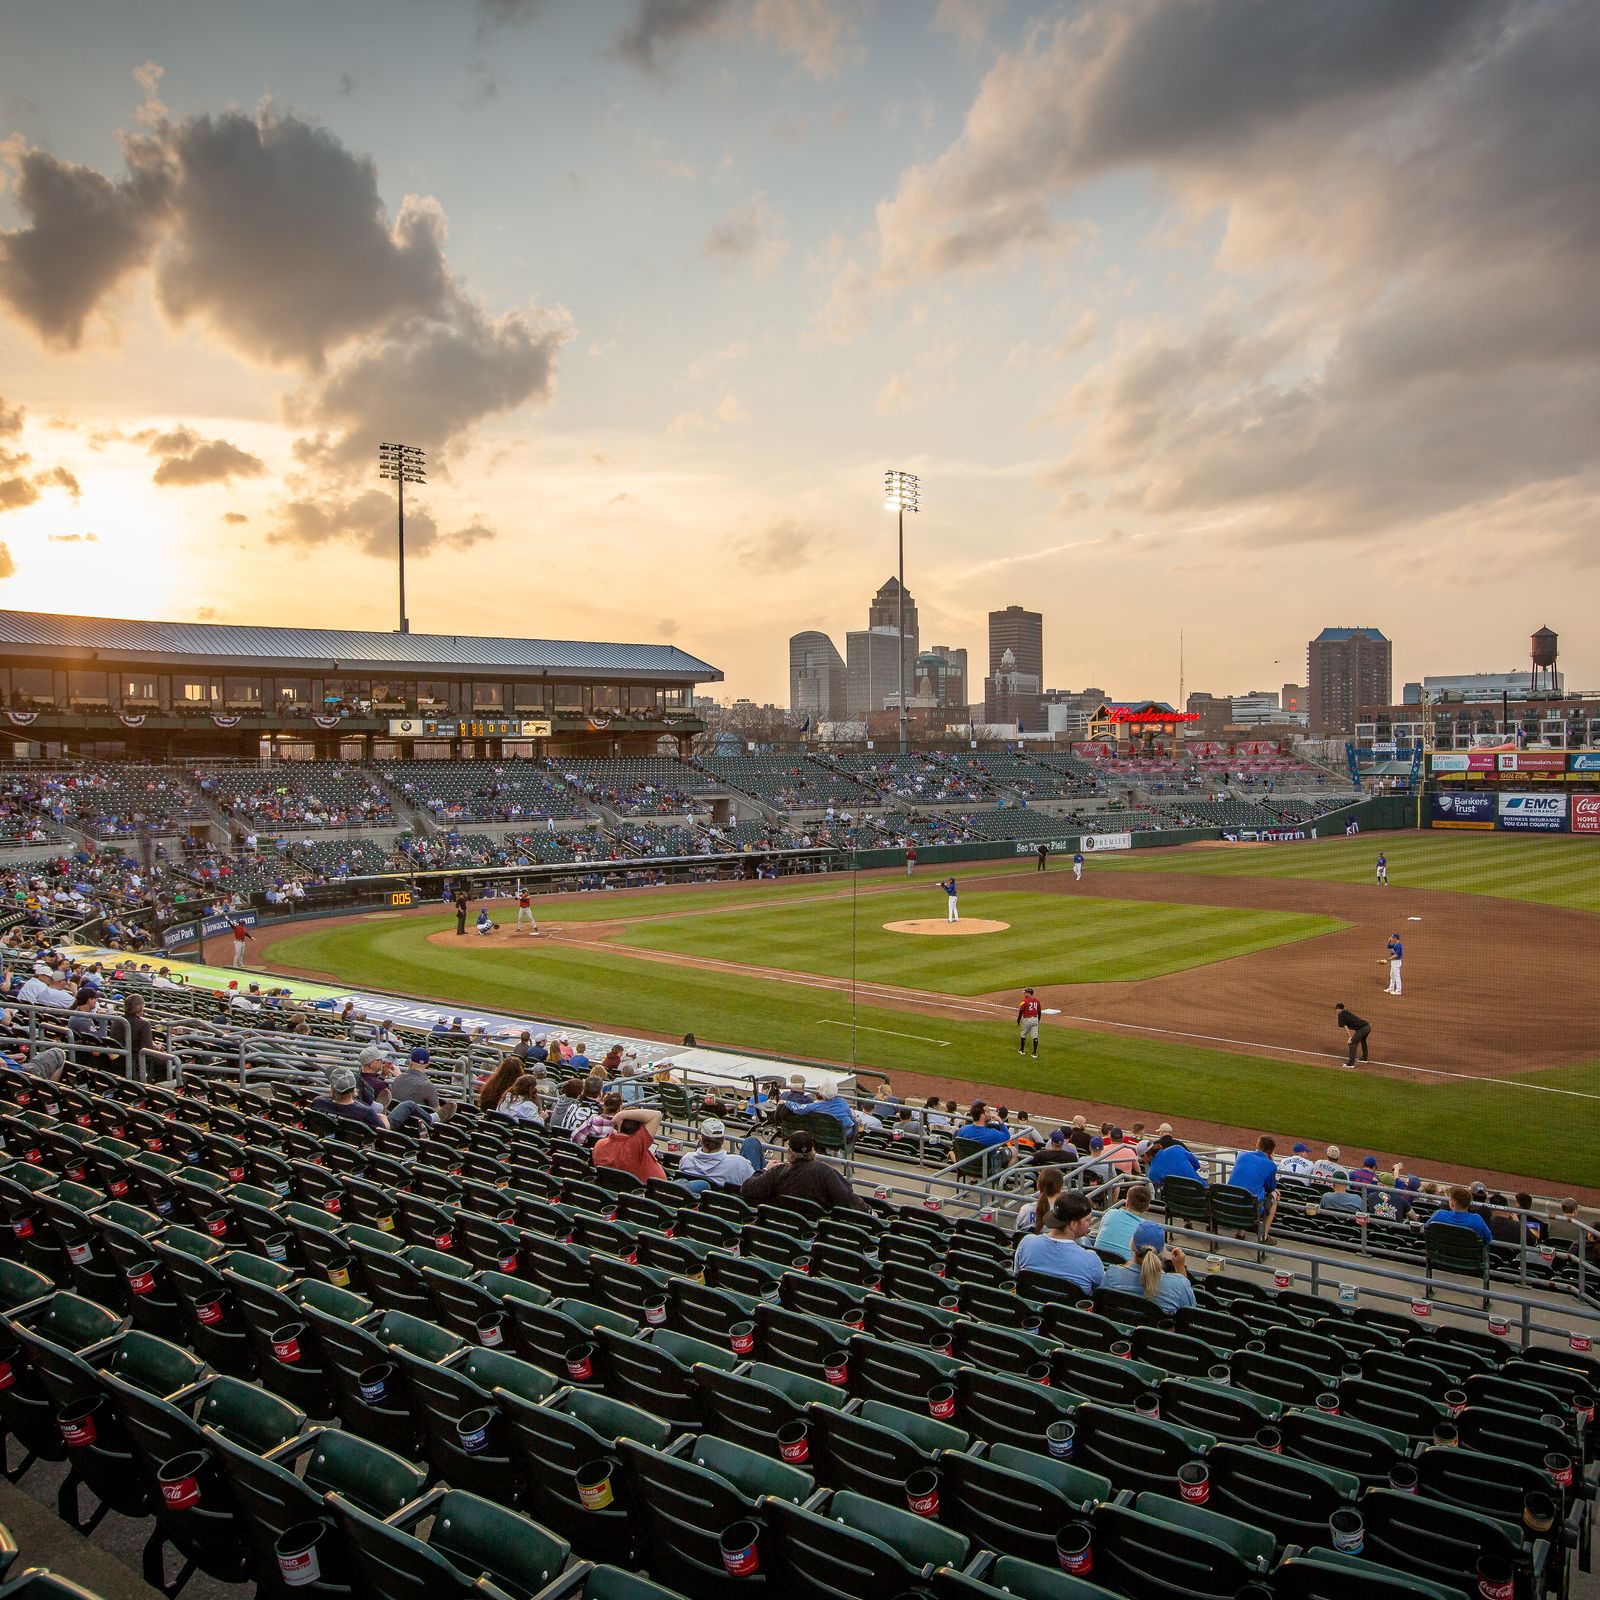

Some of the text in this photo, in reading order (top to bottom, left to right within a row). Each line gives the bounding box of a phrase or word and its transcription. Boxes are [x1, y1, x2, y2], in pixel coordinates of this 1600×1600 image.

[1106, 705, 1200, 723] Budweiser
[489, 724, 495, 733] 0
[501, 724, 507, 733] 0
[1454, 797, 1488, 806] Bankers
[1524, 799, 1559, 809] EMC
[1455, 805, 1476, 813] Trust
[1017, 844, 1028, 853] Sec
[1051, 840, 1066, 850] Field
[1094, 837, 1128, 847] PREMIER
[392, 892, 412, 905] 005
[180, 927, 196, 940] Park
[342, 996, 411, 1014] Smart
[1029, 1001, 1039, 1011] 24
[1292, 1163, 1297, 1172] 1
[1319, 1164, 1336, 1172] PRIOR
